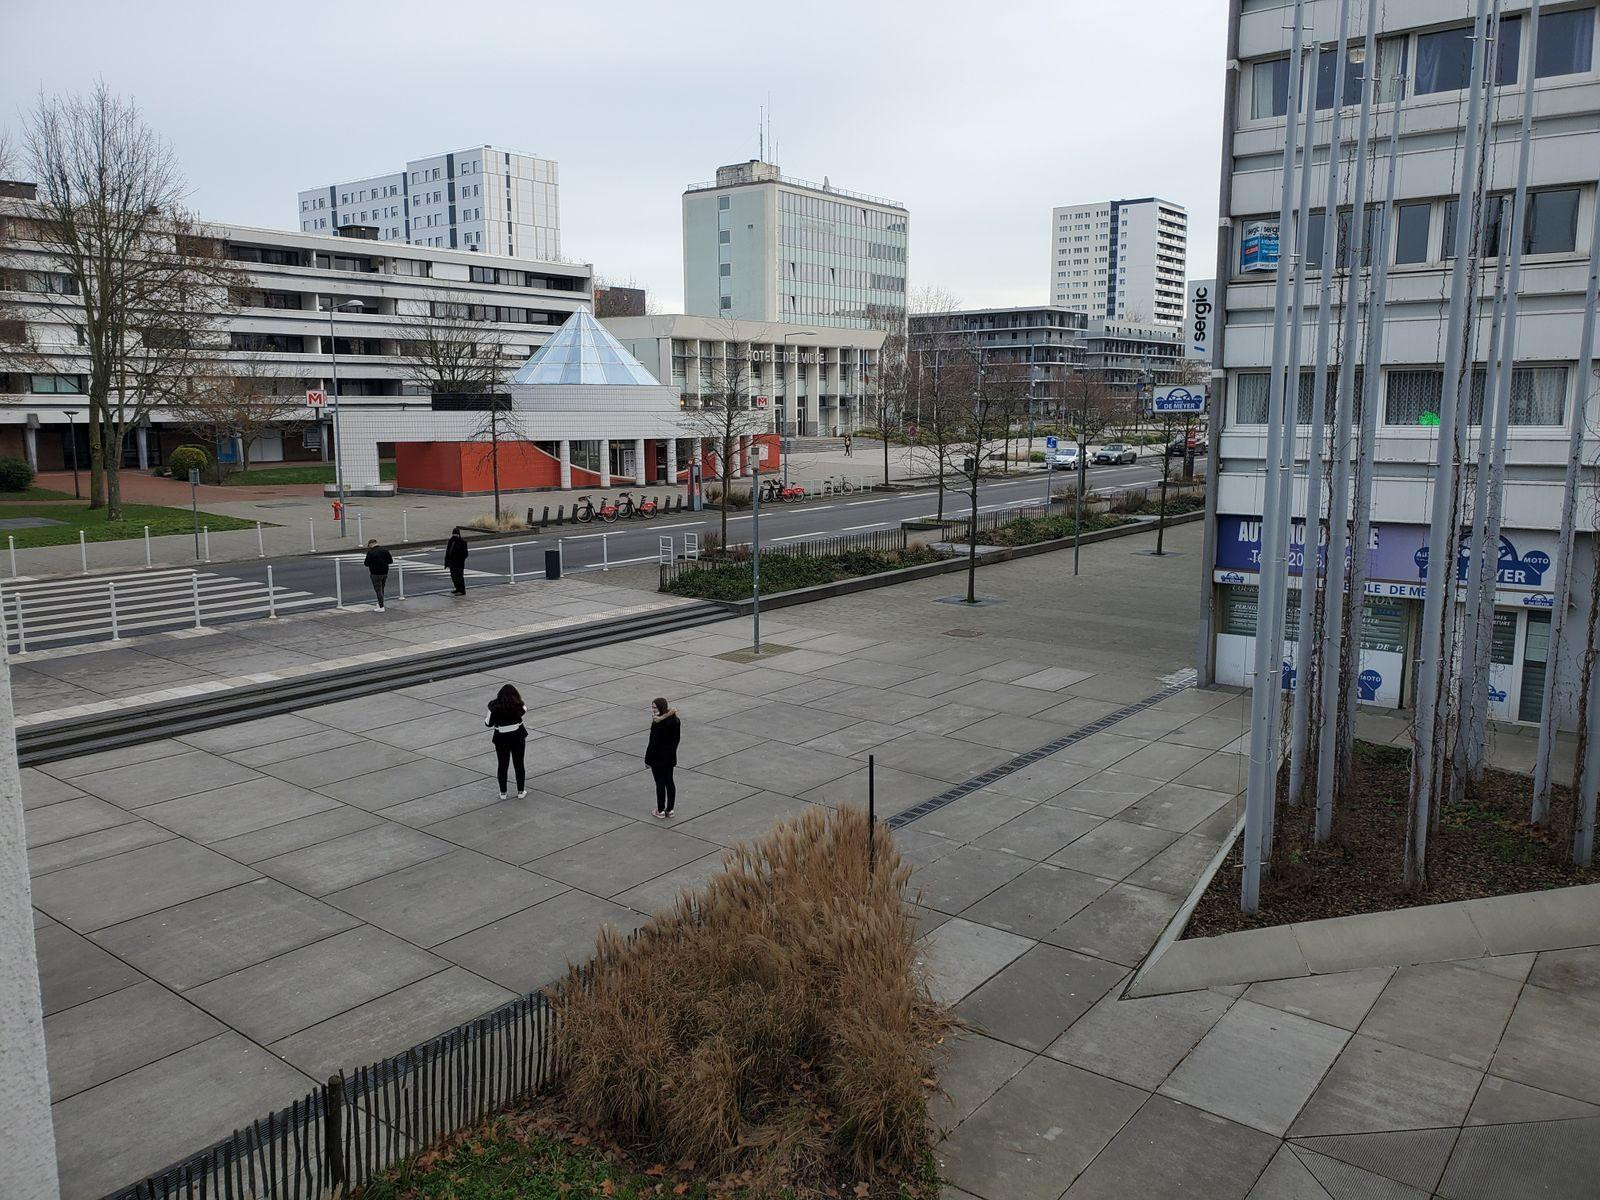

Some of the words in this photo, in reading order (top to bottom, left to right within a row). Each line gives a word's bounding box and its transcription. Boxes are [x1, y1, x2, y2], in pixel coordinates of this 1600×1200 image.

[1191, 286, 1212, 342] sergic
[1523, 556, 1549, 564] MOTO
[1389, 585, 1406, 595] DE
[1376, 643, 1390, 651] DE
